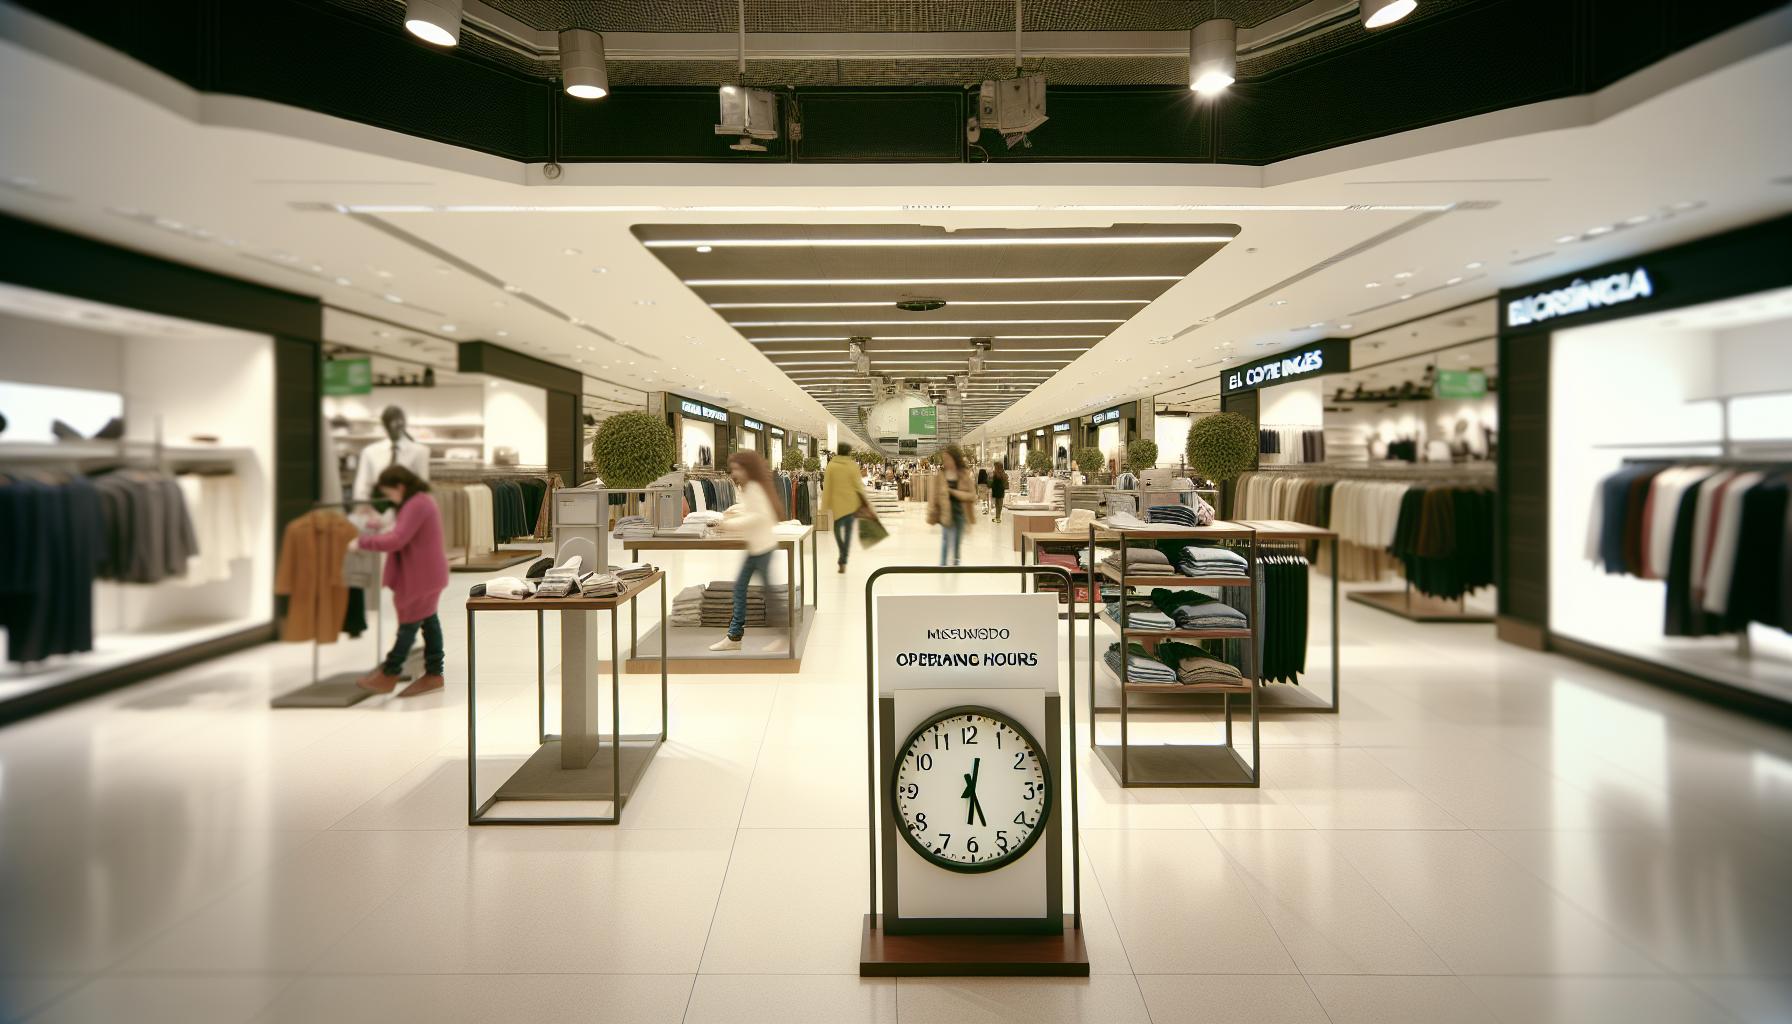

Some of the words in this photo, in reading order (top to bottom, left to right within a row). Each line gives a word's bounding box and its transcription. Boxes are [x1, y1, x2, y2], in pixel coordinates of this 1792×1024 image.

[983, 652, 1038, 666] HOURS
[934, 732, 949, 750] 11
[962, 725, 978, 745] 12
[996, 731, 1001, 750] 1
[916, 753, 933, 771] 10
[1013, 752, 1026, 770] 2
[906, 783, 919, 799] 9
[1023, 782, 1035, 800] 3
[915, 812, 928, 831] 8
[938, 833, 951, 850] 7
[966, 836, 979, 853] 6
[995, 830, 1009, 854] 5
